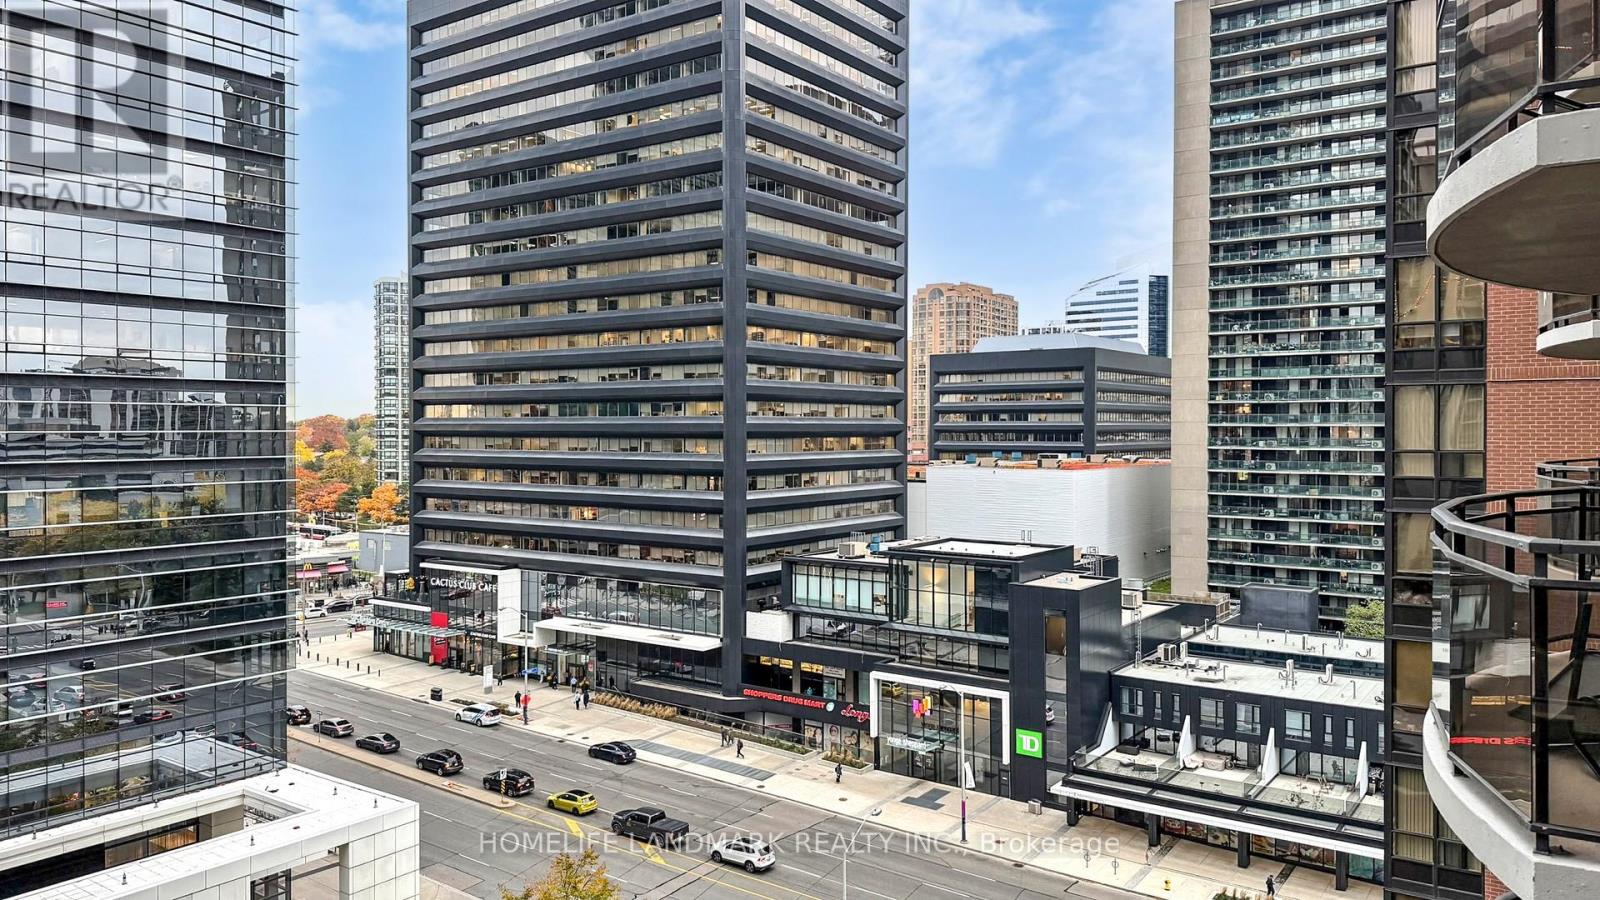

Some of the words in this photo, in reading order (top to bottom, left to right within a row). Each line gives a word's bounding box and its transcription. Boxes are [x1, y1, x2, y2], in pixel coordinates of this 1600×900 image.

[430, 577, 458, 589] CACTUS
[459, 579, 477, 591] CLUB
[478, 582, 497, 593] CAFE
[743, 688, 782, 701] SHOPPERS
[783, 695, 803, 705] DRUG
[804, 699, 825, 709] MART
[1019, 734, 1040, 752] TD
